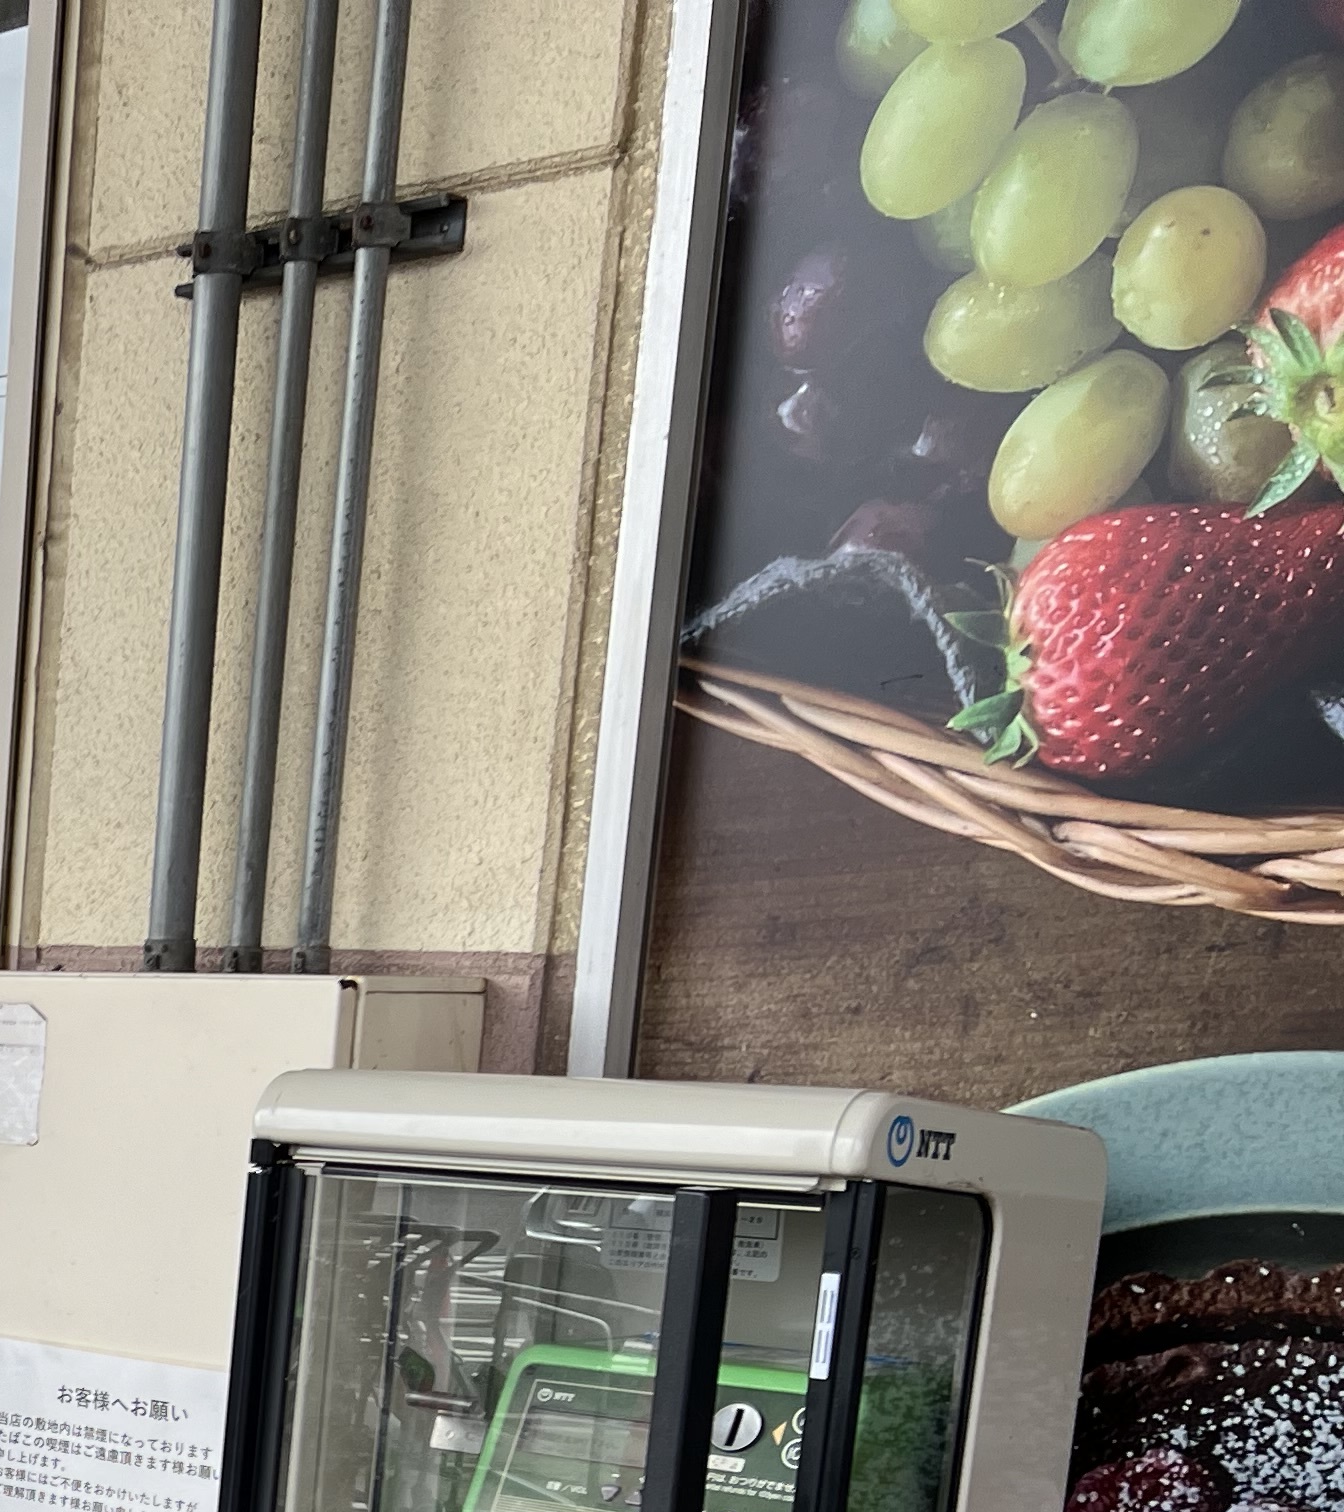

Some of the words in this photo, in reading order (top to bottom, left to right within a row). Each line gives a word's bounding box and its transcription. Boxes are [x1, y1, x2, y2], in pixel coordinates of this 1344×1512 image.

[916, 1129, 956, 1161] NTT
[56, 1384, 189, 1422] お客様へお願い
